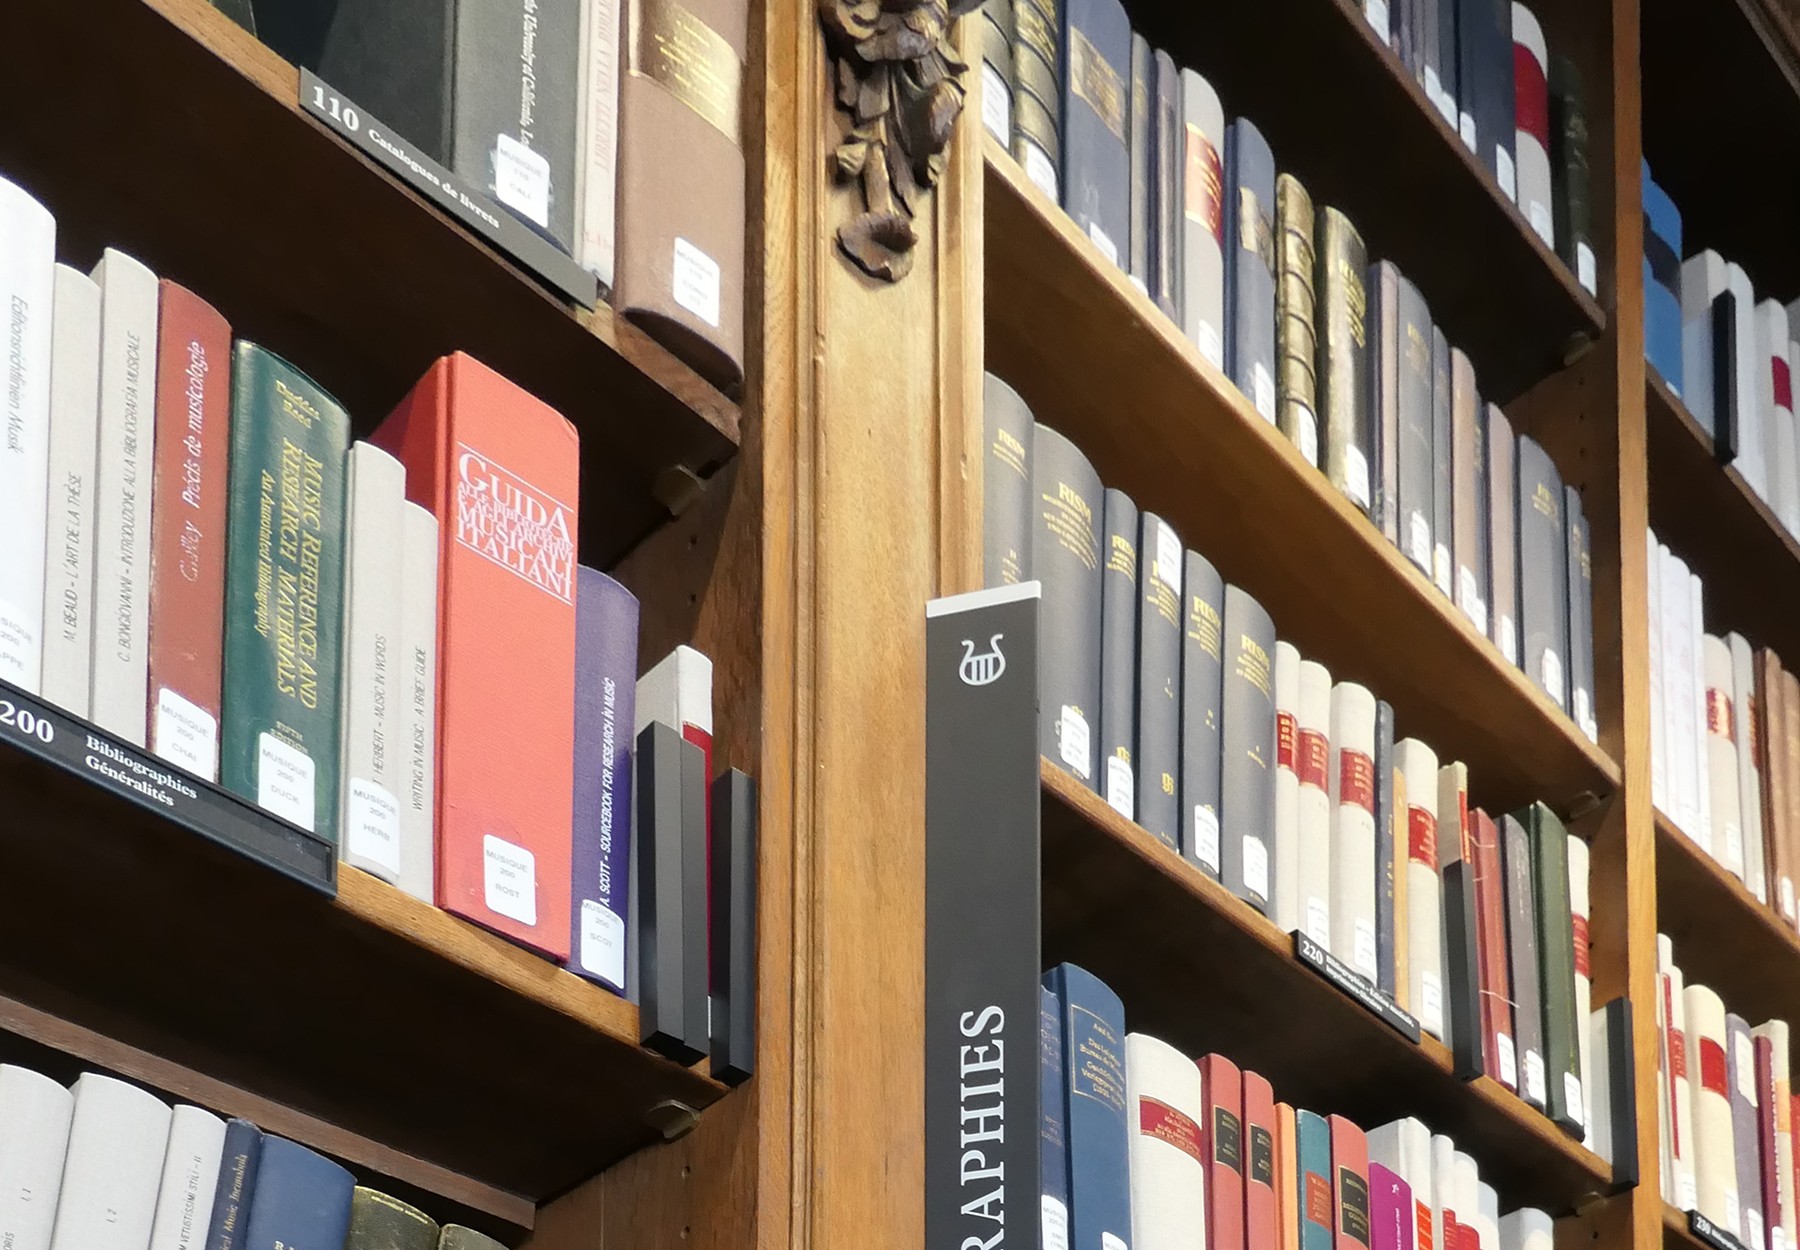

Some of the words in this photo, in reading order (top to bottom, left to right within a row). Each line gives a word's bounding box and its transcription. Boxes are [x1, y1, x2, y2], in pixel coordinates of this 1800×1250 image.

[313, 86, 359, 131] 110
[368, 129, 440, 186] Catalogues
[442, 183, 459, 198] de
[459, 193, 500, 228] livrets
[499, 149, 542, 178] MUSIQUE
[126, 330, 141, 386] MUSICALE
[184, 340, 209, 436] musicologie
[8, 411, 24, 454] Musik
[121, 385, 138, 458] BIBLIOGRAFIA
[182, 437, 203, 457] de
[62, 471, 81, 508] THÈSE
[122, 459, 137, 486] ALLA
[181, 458, 201, 509] Précis
[261, 468, 276, 493] An
[302, 449, 324, 530] MUSIC
[66, 510, 80, 526] LA
[279, 436, 304, 562] RESEARCH
[459, 453, 573, 544] GUIDA
[1059, 482, 1092, 524] RISM
[65, 526, 80, 544] DE
[119, 488, 136, 566] INTRODUZIONE
[257, 492, 276, 556] Annotated
[458, 504, 573, 585] MUSICALI
[457, 517, 572, 601] ITALIANI
[63, 588, 79, 628] BEAUD
[118, 574, 133, 650] BONGIOVANNI
[253, 555, 273, 638] Bibliography
[299, 530, 322, 660] REFERENCE
[277, 566, 298, 698] MATERIALS
[374, 633, 387, 673] WORDS
[415, 646, 427, 676] GUIDE
[299, 656, 318, 709] AND
[373, 684, 386, 720] MUSIC
[414, 679, 426, 707] BRIEF
[603, 677, 617, 711] MUSIC
[161, 704, 209, 738] MUSIQUE
[601, 711, 615, 724] IN
[0, 700, 54, 743] 200
[86, 734, 198, 799] Bibliographies
[372, 729, 385, 776] HERBERT
[412, 723, 425, 758] MUSIC
[601, 722, 615, 770] RESEARCH
[85, 755, 175, 806] Généralités
[262, 748, 308, 780] MUSIQUE
[600, 769, 614, 792] FOR
[270, 784, 300, 805] DUCK
[353, 789, 397, 816] MUSIQUE
[411, 768, 423, 811] WRITING
[363, 823, 391, 842] HERB
[600, 790, 613, 854] SOURCEBOOK
[486, 849, 529, 873] MUSIQUE
[599, 861, 612, 902] SCOTT
[495, 883, 520, 899] ROST
[1302, 940, 1324, 965] 220
[186, 1167, 201, 1191] STILI
[179, 1190, 197, 1243] VETUSTISSIMI
[223, 1204, 239, 1233] Music
